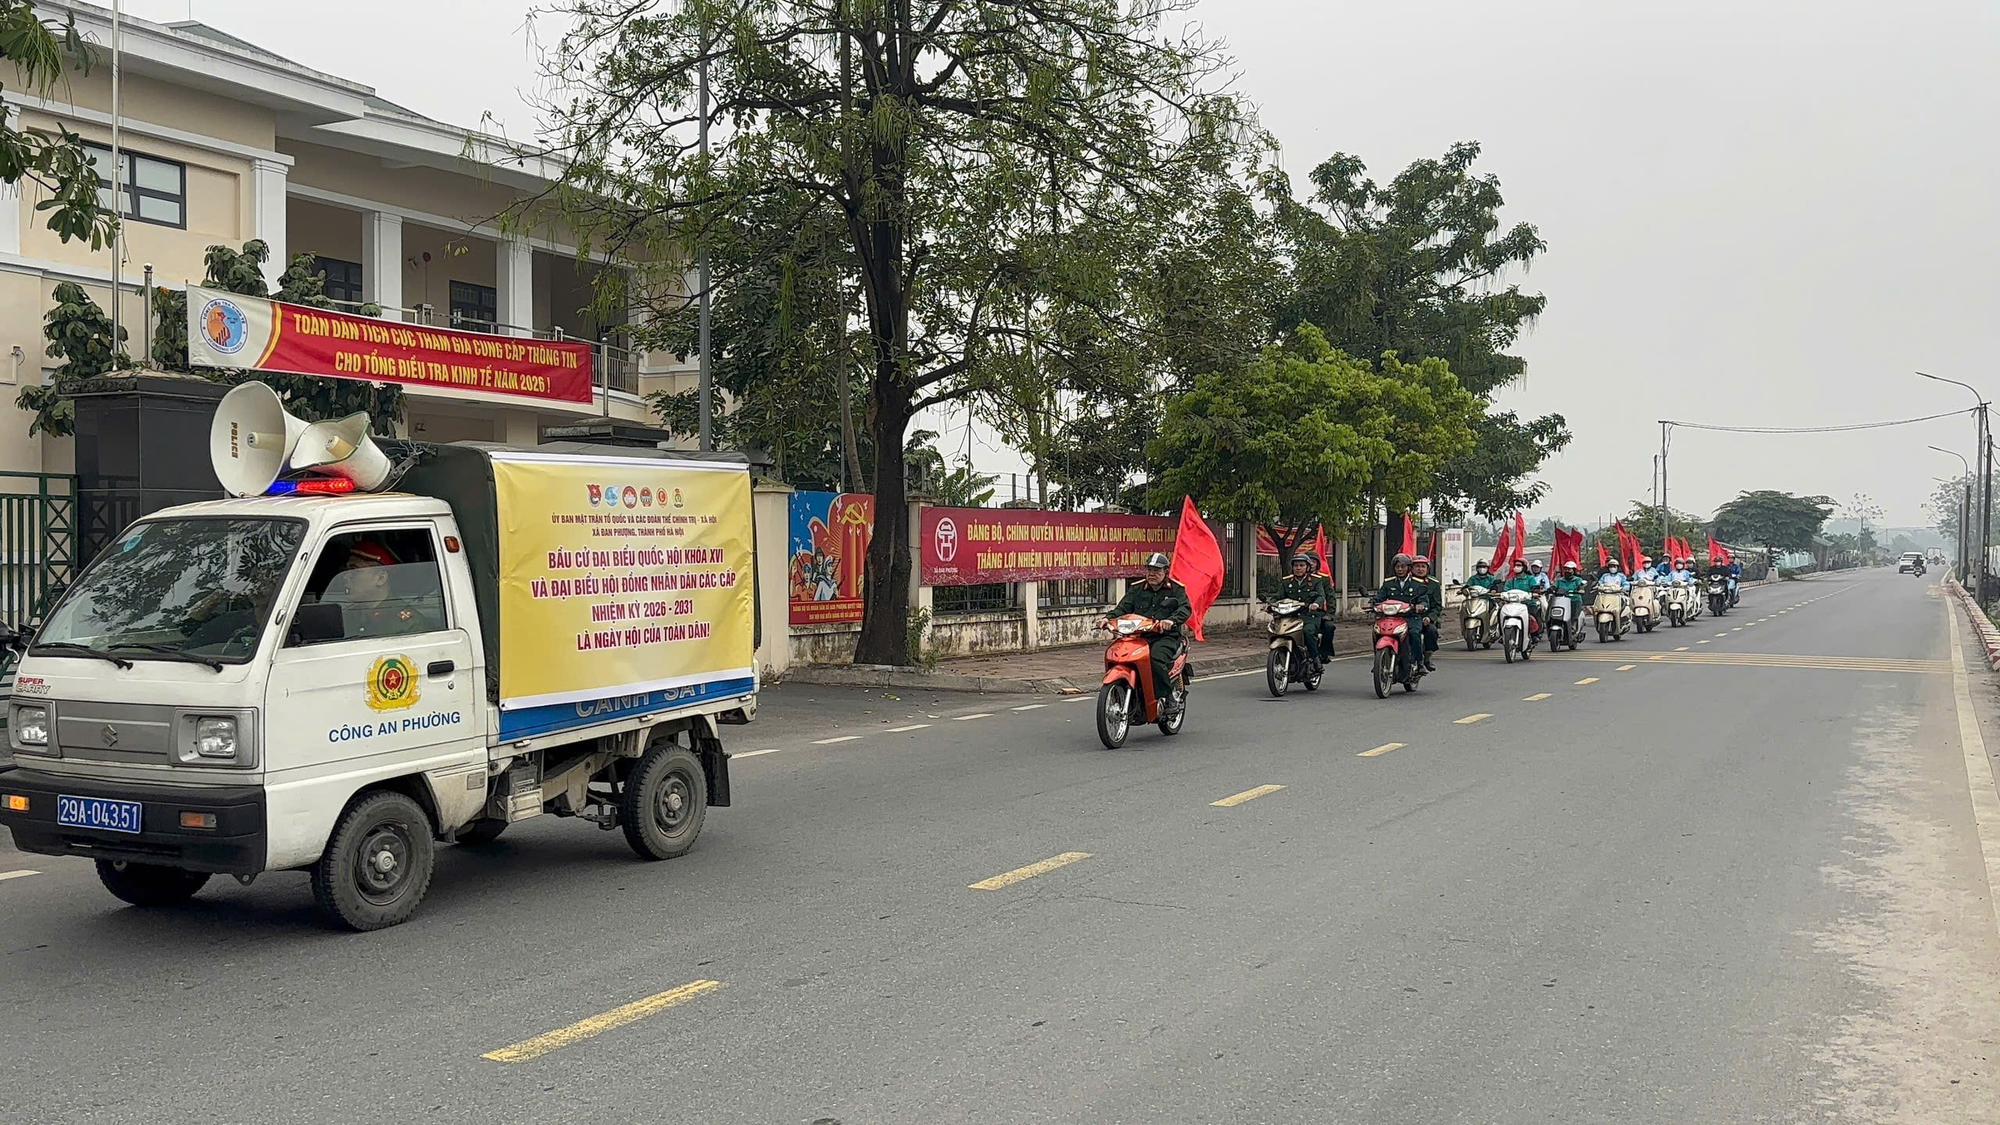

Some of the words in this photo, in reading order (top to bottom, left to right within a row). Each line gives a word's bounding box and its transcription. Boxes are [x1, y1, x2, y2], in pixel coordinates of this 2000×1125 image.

[293, 312, 329, 337] TOÀN
[331, 318, 359, 340] DÂN
[360, 321, 390, 344] TÍCH
[391, 328, 416, 350] CỰC
[416, 332, 450, 352] THAM
[452, 337, 472, 354] GIA
[473, 340, 503, 359] CUNG
[505, 340, 526, 362] CẤP
[528, 344, 560, 366] THÔNG
[561, 351, 577, 369] TIN
[335, 350, 361, 373] CHO
[364, 349, 396, 376] TỔNG
[398, 355, 426, 380] ĐIỀU
[427, 362, 449, 382] TRA
[451, 364, 478, 385] KINH
[480, 364, 492, 387] TẾ
[494, 368, 518, 390] NĂM
[520, 374, 545, 393] 2026
[561, 514, 574, 523] BAN
[967, 518, 990, 541] ĐẢNG
[991, 522, 1005, 544] BỘ,
[1006, 522, 1029, 541] CHÍNH
[1055, 523, 1064, 541] VÀ
[1066, 523, 1084, 542] NHÂN
[1086, 525, 1099, 542] DÂN
[1109, 527, 1121, 542] ĐAN
[548, 546, 572, 569] BẦU
[575, 546, 590, 568] CỬ
[592, 552, 609, 570] ĐẠI
[613, 545, 635, 566] BIỂU
[638, 546, 664, 567] QUỐC
[667, 547, 682, 567] HỘI
[684, 546, 706, 564] KHÓA
[709, 548, 724, 563] XVI
[977, 546, 1002, 570] THẮNG
[1004, 551, 1016, 571] LỢI
[1018, 549, 1041, 571] NHIỆM
[1043, 552, 1052, 570] VỤ
[1054, 549, 1071, 567] PHÁT
[1092, 551, 1108, 566] KINH
[1109, 547, 1116, 566] TẾ
[531, 577, 548, 597] VÀ
[551, 580, 571, 600] ĐẠI
[574, 572, 599, 595] BIỂU
[602, 576, 619, 597] HỘI
[622, 571, 648, 592] ĐỒNG
[651, 571, 677, 591] NHÂN
[680, 570, 697, 589] DÂN
[699, 570, 716, 588] CÁC
[719, 568, 736, 587] CẤP
[592, 601, 626, 623] NHIỆM
[628, 600, 640, 619] KỲ
[644, 601, 666, 618] 2026
[674, 600, 693, 615] 2031
[577, 631, 591, 650] LÀ
[594, 628, 621, 648] NGÀY
[625, 626, 640, 648] HỘI
[643, 623, 661, 643] CỦA
[663, 623, 685, 641] TOÀN
[688, 621, 710, 638] DÂN!
[16, 684, 51, 694] CARRY
[329, 724, 373, 742] CÔNG
[378, 720, 397, 736] AN
[402, 711, 460, 732] PHƯỜNG
[60, 799, 137, 829] 29A-043.51
